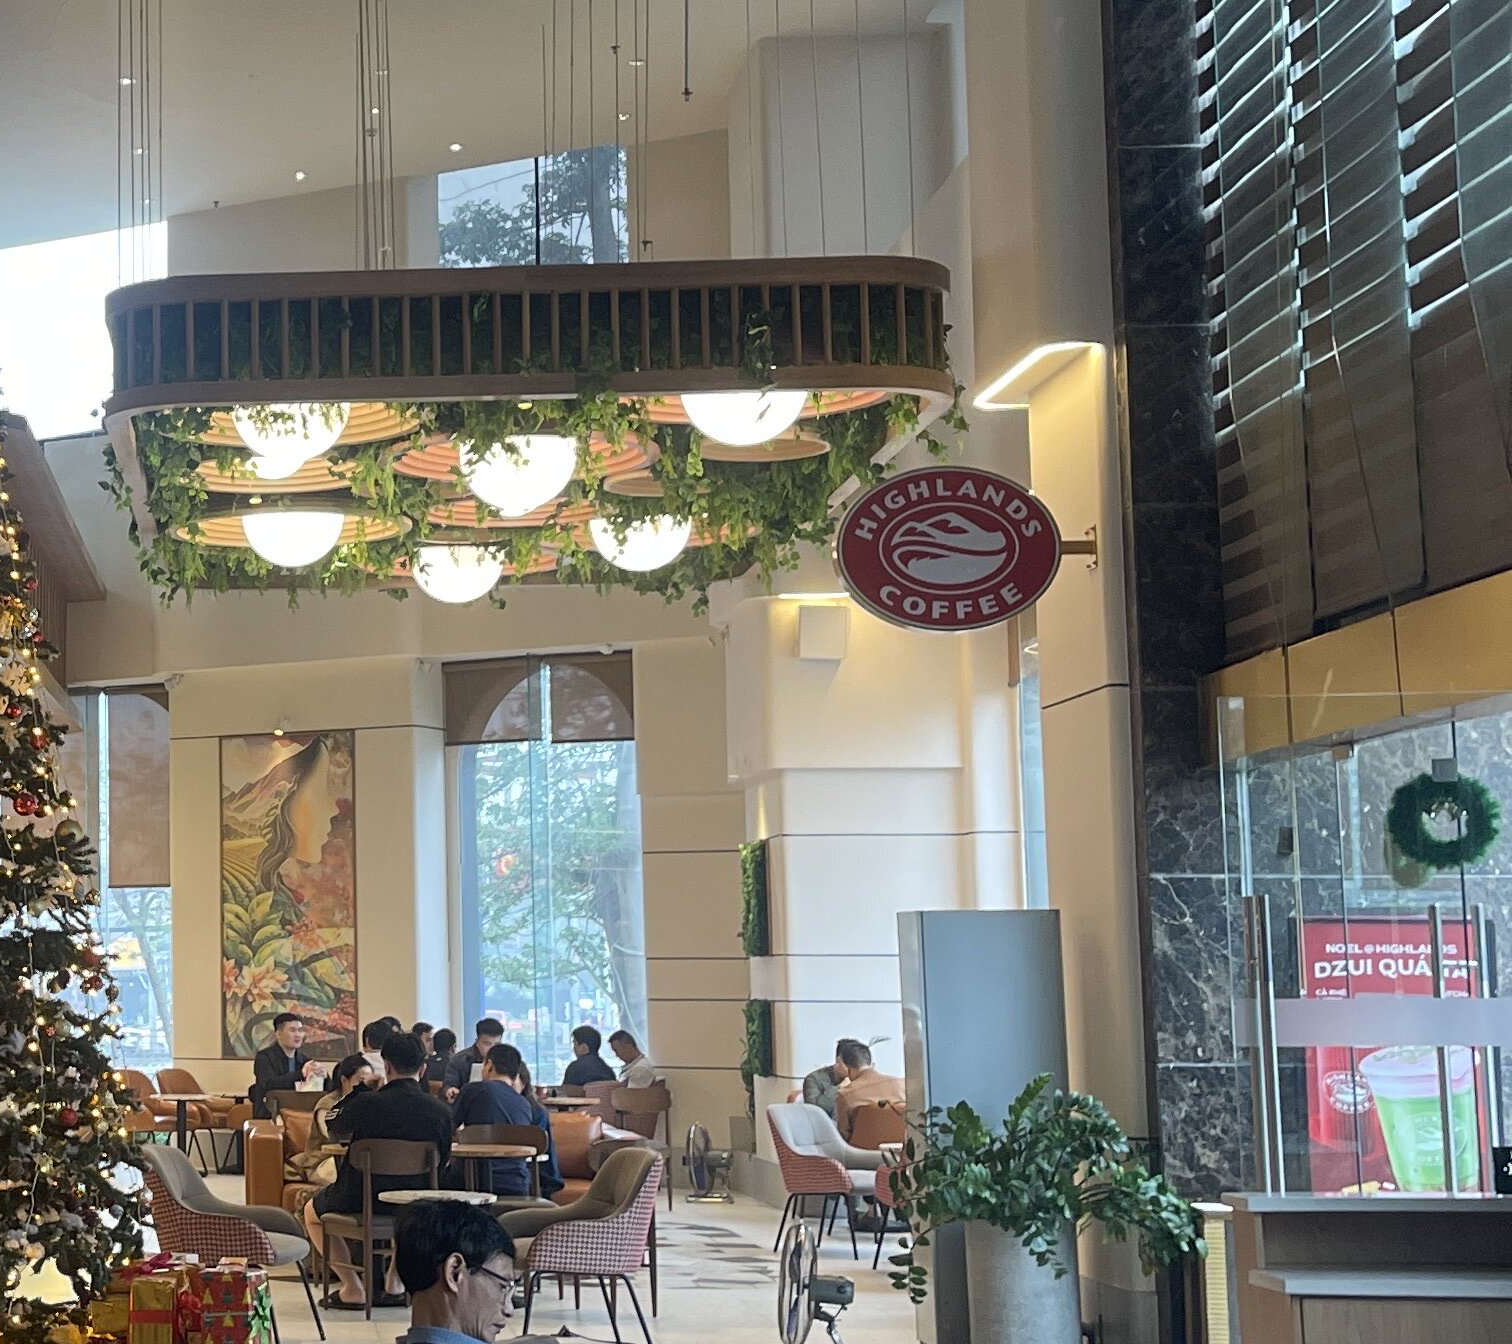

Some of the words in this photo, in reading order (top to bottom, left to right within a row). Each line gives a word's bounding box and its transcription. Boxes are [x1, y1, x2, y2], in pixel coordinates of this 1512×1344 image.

[854, 477, 1043, 542] HIGHLANDS
[878, 581, 1024, 620] COFFEE
[1313, 959, 1373, 979] DZUI
[1378, 953, 1433, 979] QUÁ
